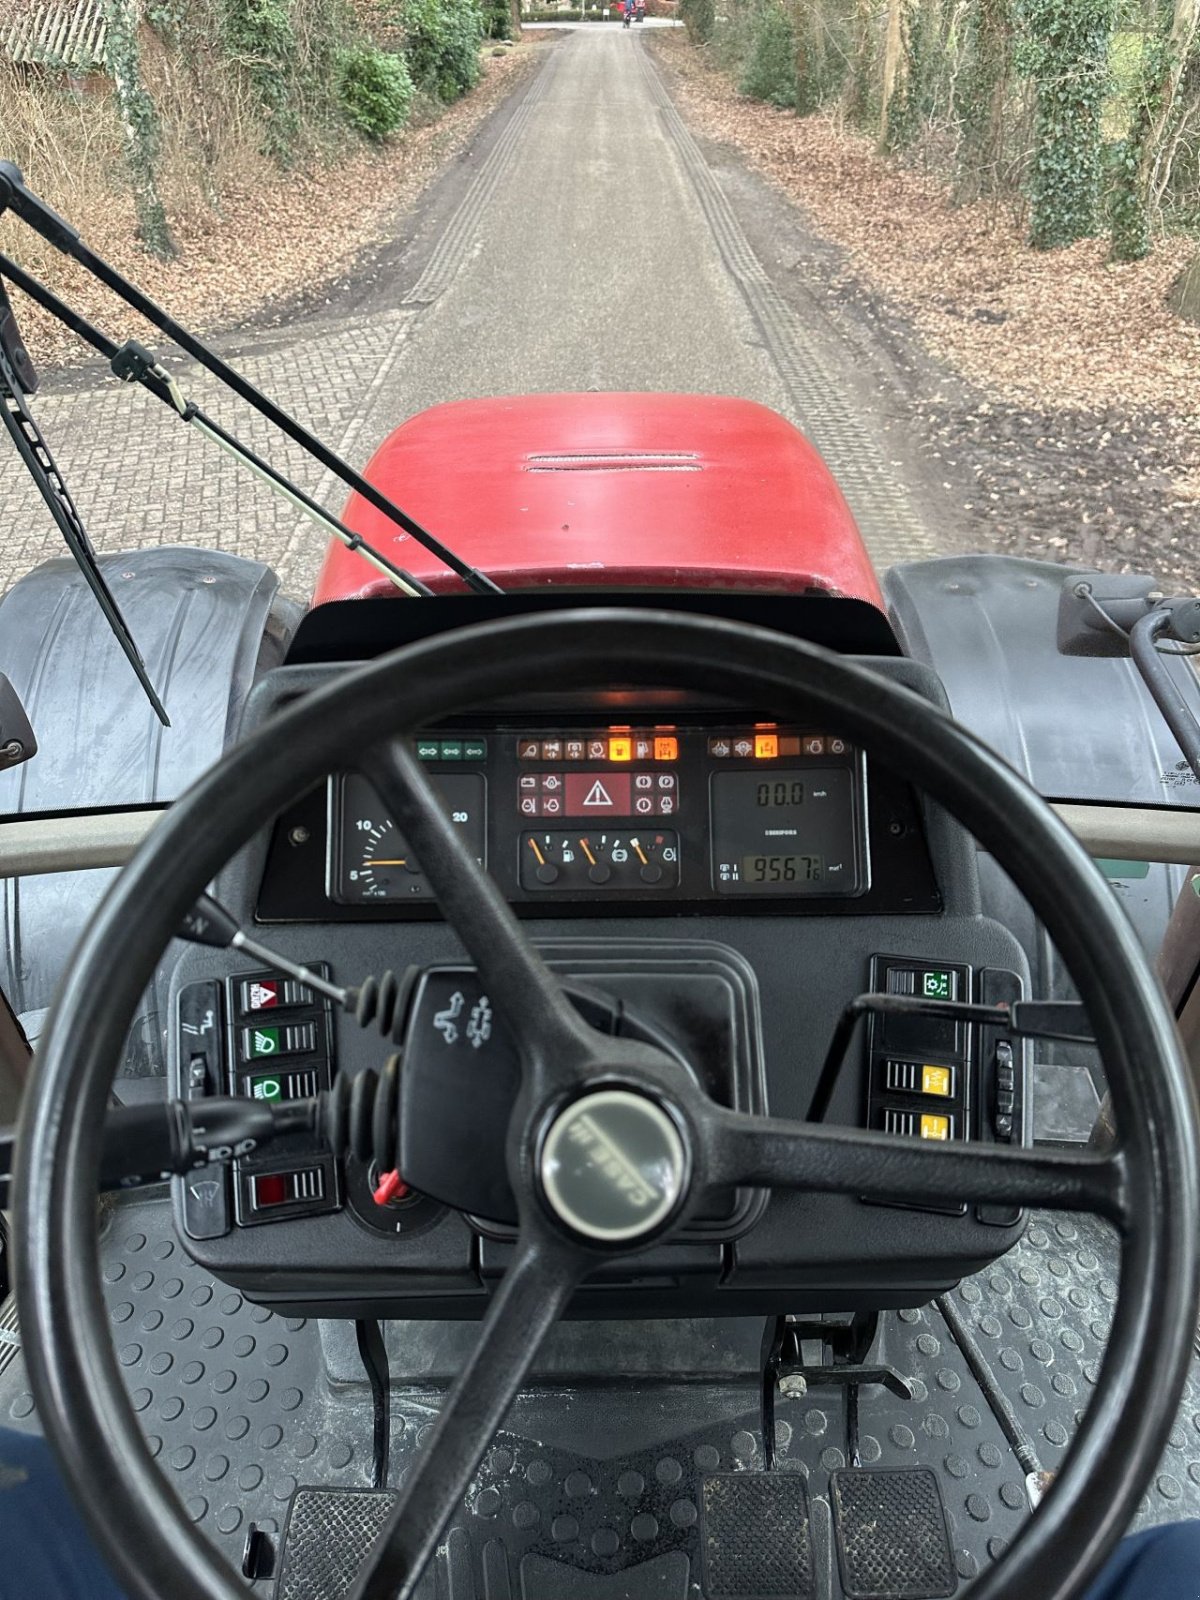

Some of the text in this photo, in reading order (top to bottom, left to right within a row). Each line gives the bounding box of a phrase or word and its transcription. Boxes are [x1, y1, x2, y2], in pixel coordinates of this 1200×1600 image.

[757, 783, 804, 807] 00.0
[452, 812, 468, 822] 20
[356, 820, 372, 831] 10
[350, 870, 358, 881] 5
